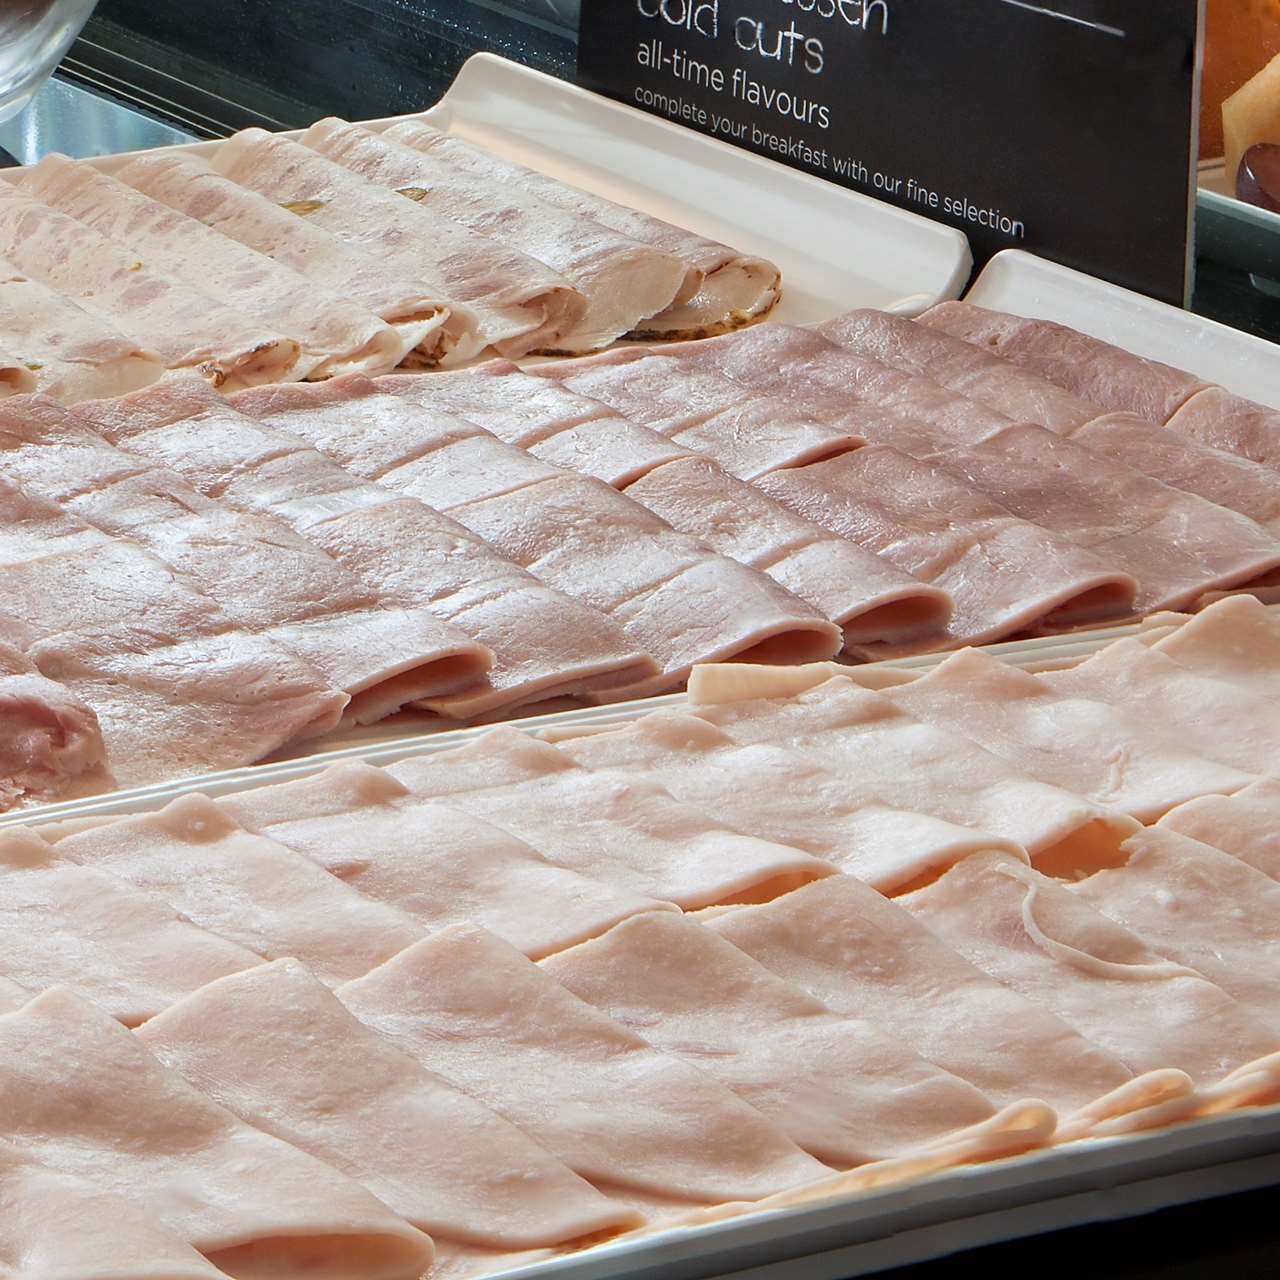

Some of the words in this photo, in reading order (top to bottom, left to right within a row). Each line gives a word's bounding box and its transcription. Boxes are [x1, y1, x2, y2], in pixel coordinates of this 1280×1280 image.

[637, 38, 725, 92] all-time
[732, 68, 831, 130] flavours
[734, 16, 824, 74] cuts
[634, 86, 708, 126] complete
[711, 113, 749, 141] your
[751, 124, 828, 170] breakfast
[831, 152, 869, 185] with
[872, 171, 903, 195] our
[906, 179, 940, 209] fine
[942, 194, 1026, 240] selection
